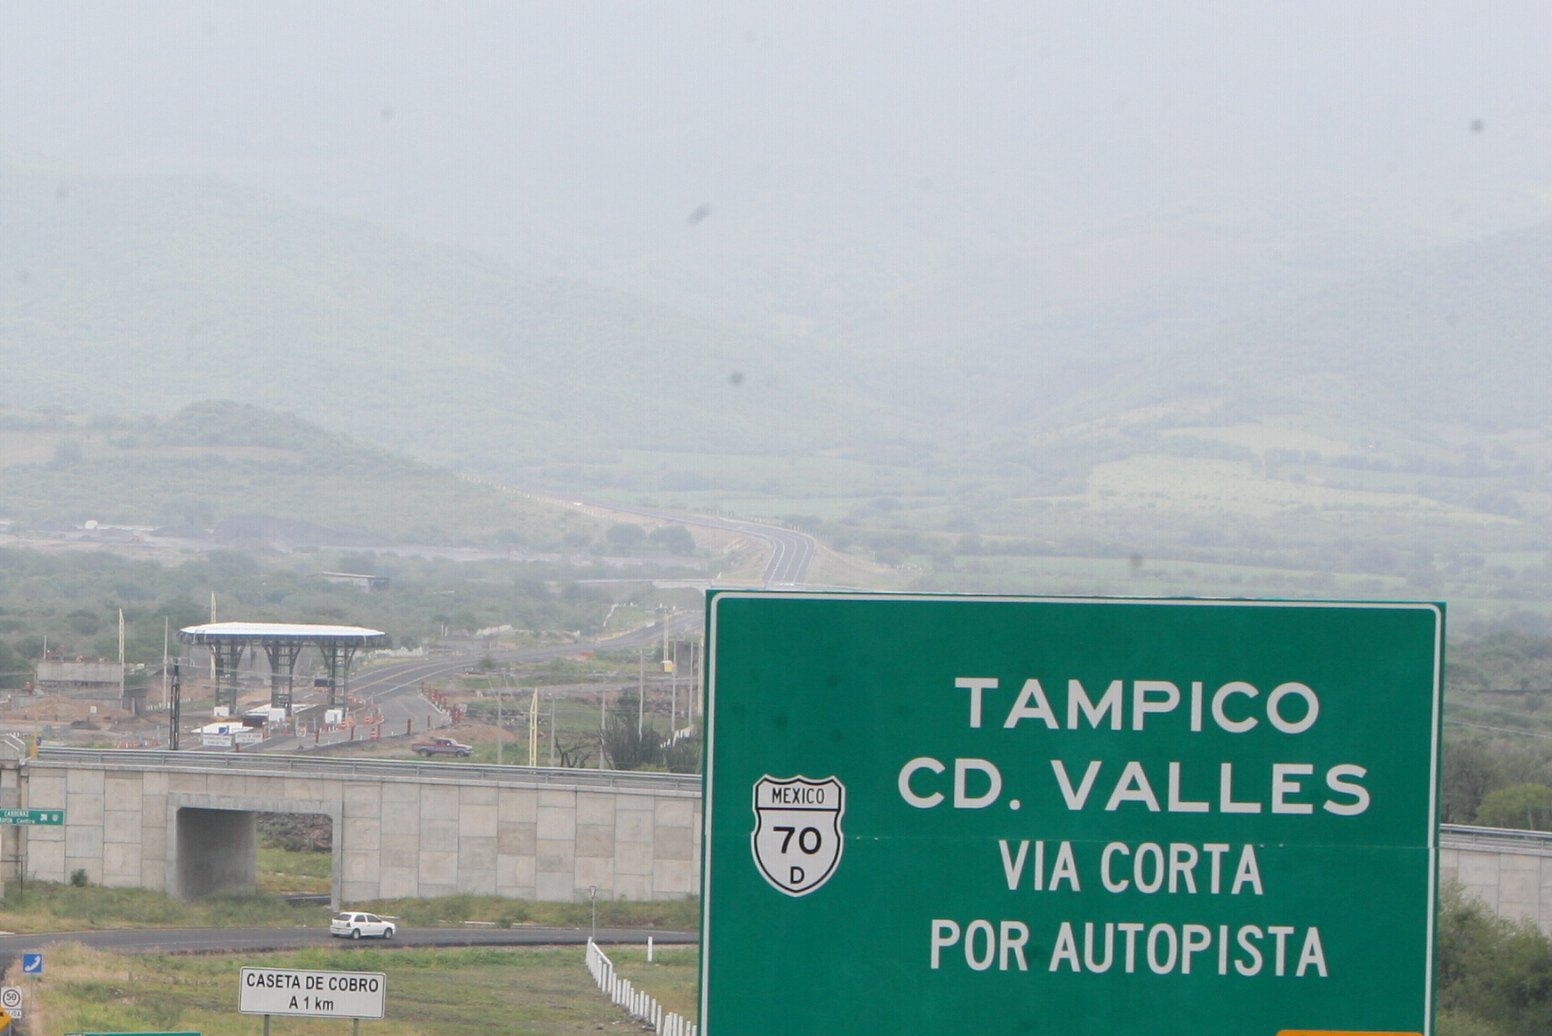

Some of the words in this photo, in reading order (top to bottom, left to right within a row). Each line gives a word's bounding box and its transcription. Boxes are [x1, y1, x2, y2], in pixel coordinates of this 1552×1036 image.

[954, 677, 1320, 734] TAMPICO
[771, 787, 825, 804] MEXICO
[898, 756, 1021, 810] CD.
[1050, 759, 1371, 816] VALLES
[772, 826, 822, 855] 70
[789, 865, 805, 884] D
[998, 839, 1081, 892] VIA
[1100, 841, 1263, 895] CORTA
[930, 919, 1029, 971] POR
[1049, 921, 1328, 978] AUTOPISTA
[246, 973, 301, 989] CASETA
[305, 976, 324, 990] DE
[328, 977, 379, 992] COBRO
[6, 993, 17, 1001] 50
[289, 996, 298, 1009] A
[303, 996, 309, 1009] 1
[315, 997, 334, 1011] km
